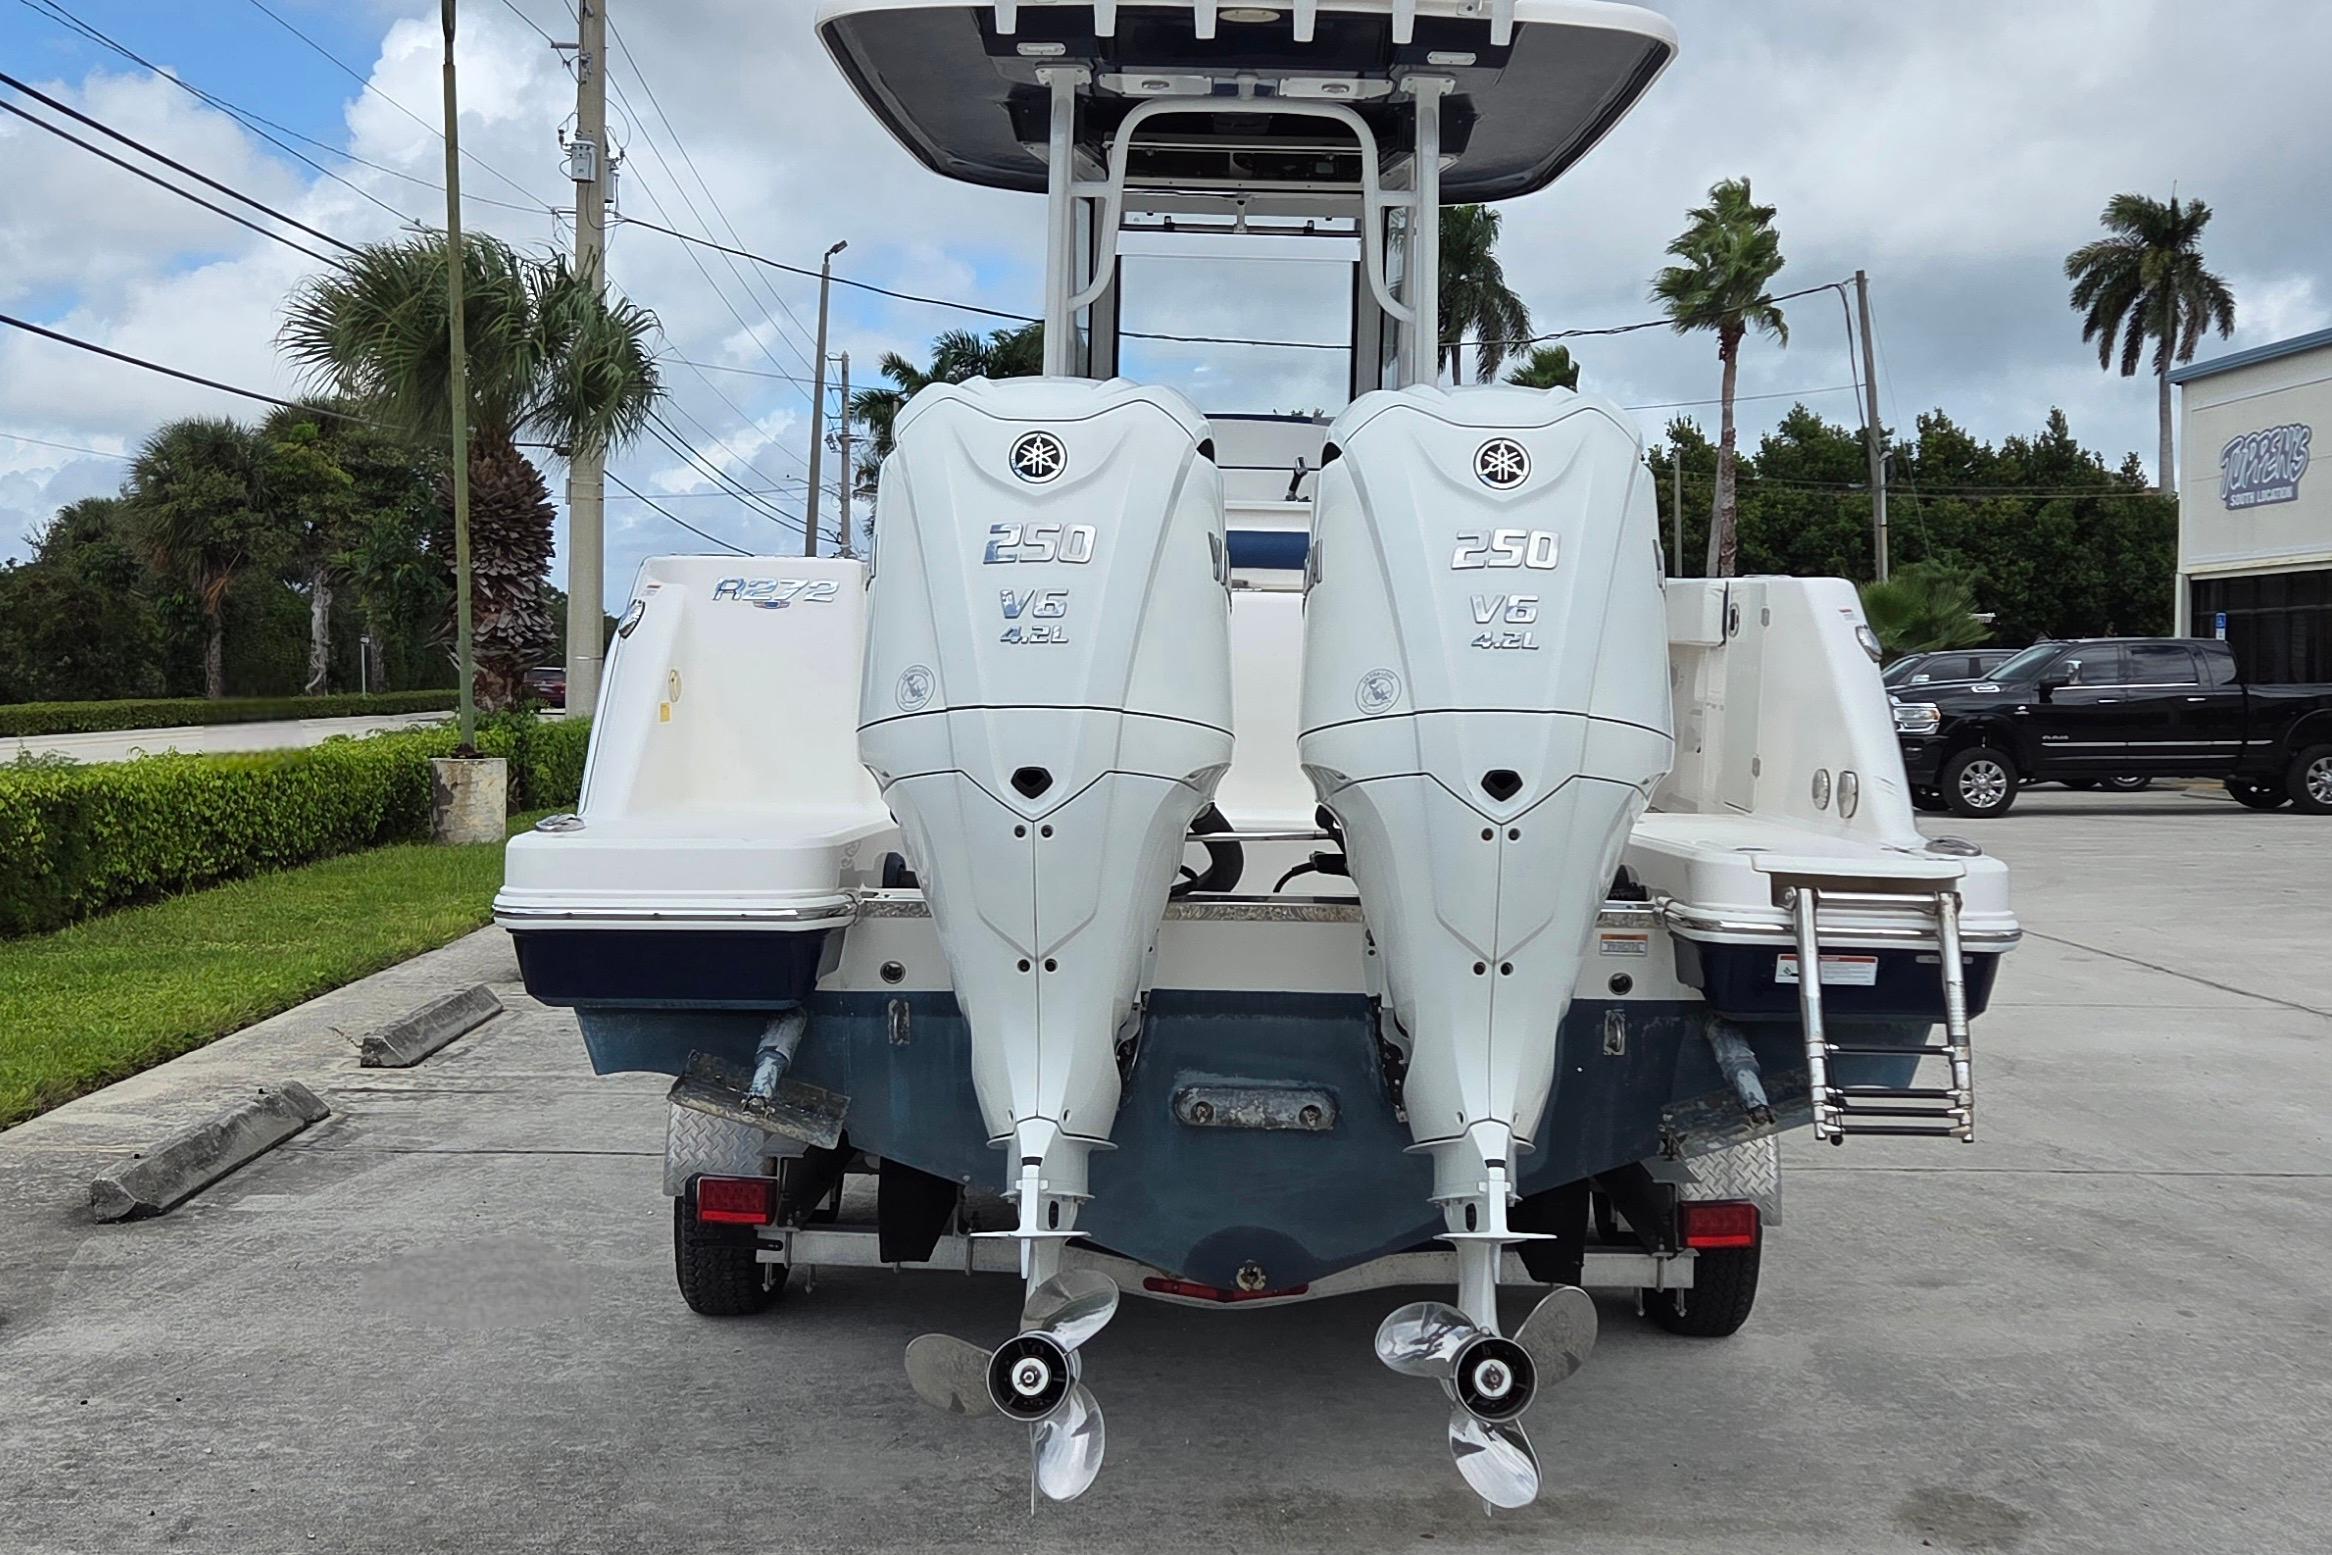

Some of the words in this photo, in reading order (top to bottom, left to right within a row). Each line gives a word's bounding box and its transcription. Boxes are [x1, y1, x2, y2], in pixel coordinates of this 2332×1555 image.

[982, 522, 1098, 565] 250
[1450, 528, 1560, 570] 250
[712, 576, 841, 603] R272
[999, 588, 1069, 619] V6
[1469, 594, 1540, 625] V6
[999, 624, 1070, 645] 4.2L
[1470, 631, 1541, 651] 4.2L
